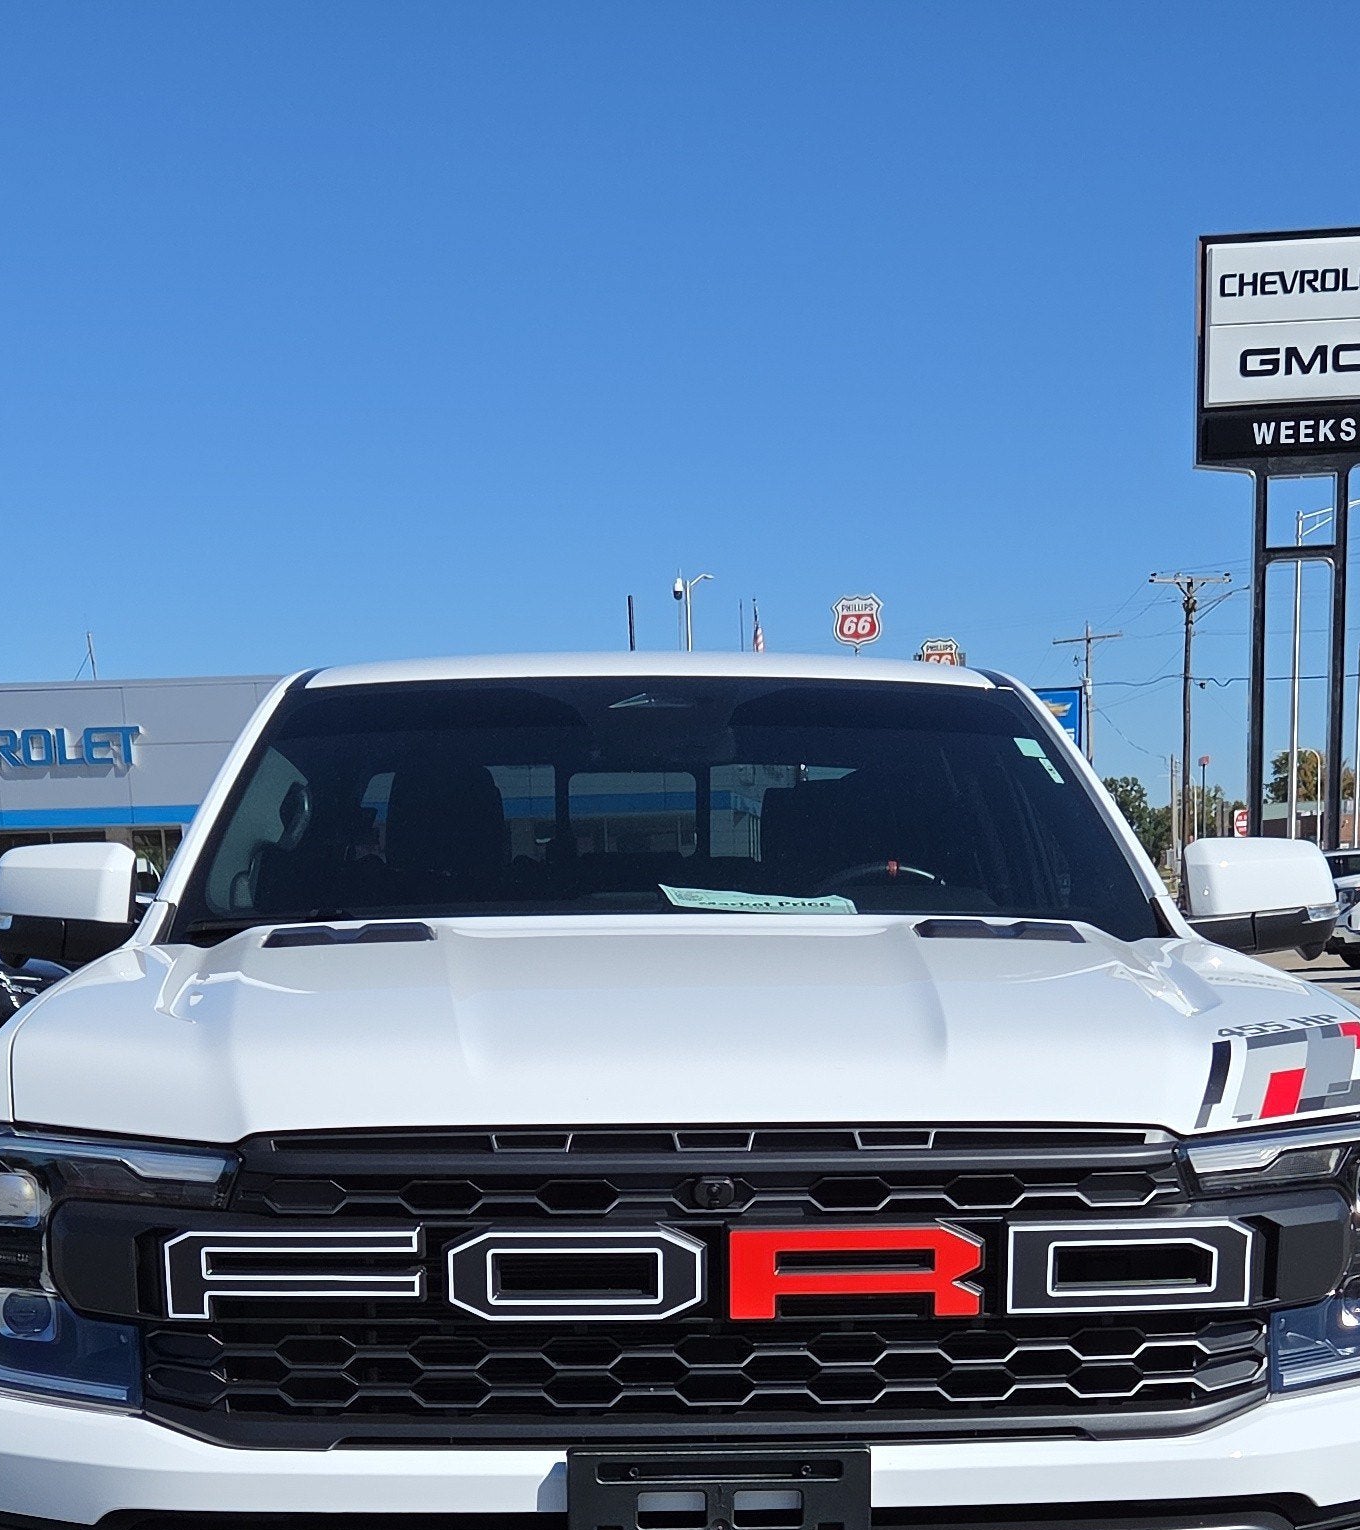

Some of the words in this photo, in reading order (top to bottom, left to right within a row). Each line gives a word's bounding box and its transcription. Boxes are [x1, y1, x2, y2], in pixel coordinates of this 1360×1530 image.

[1252, 417, 1357, 446] WEEKS
[841, 603, 874, 613] PHILLIPS
[843, 616, 872, 635] 66
[926, 643, 954, 652] PHILLIPS
[1217, 1020, 1291, 1038] 455
[1286, 1013, 1339, 1027] HP
[162, 1220, 1254, 1322] FORD
